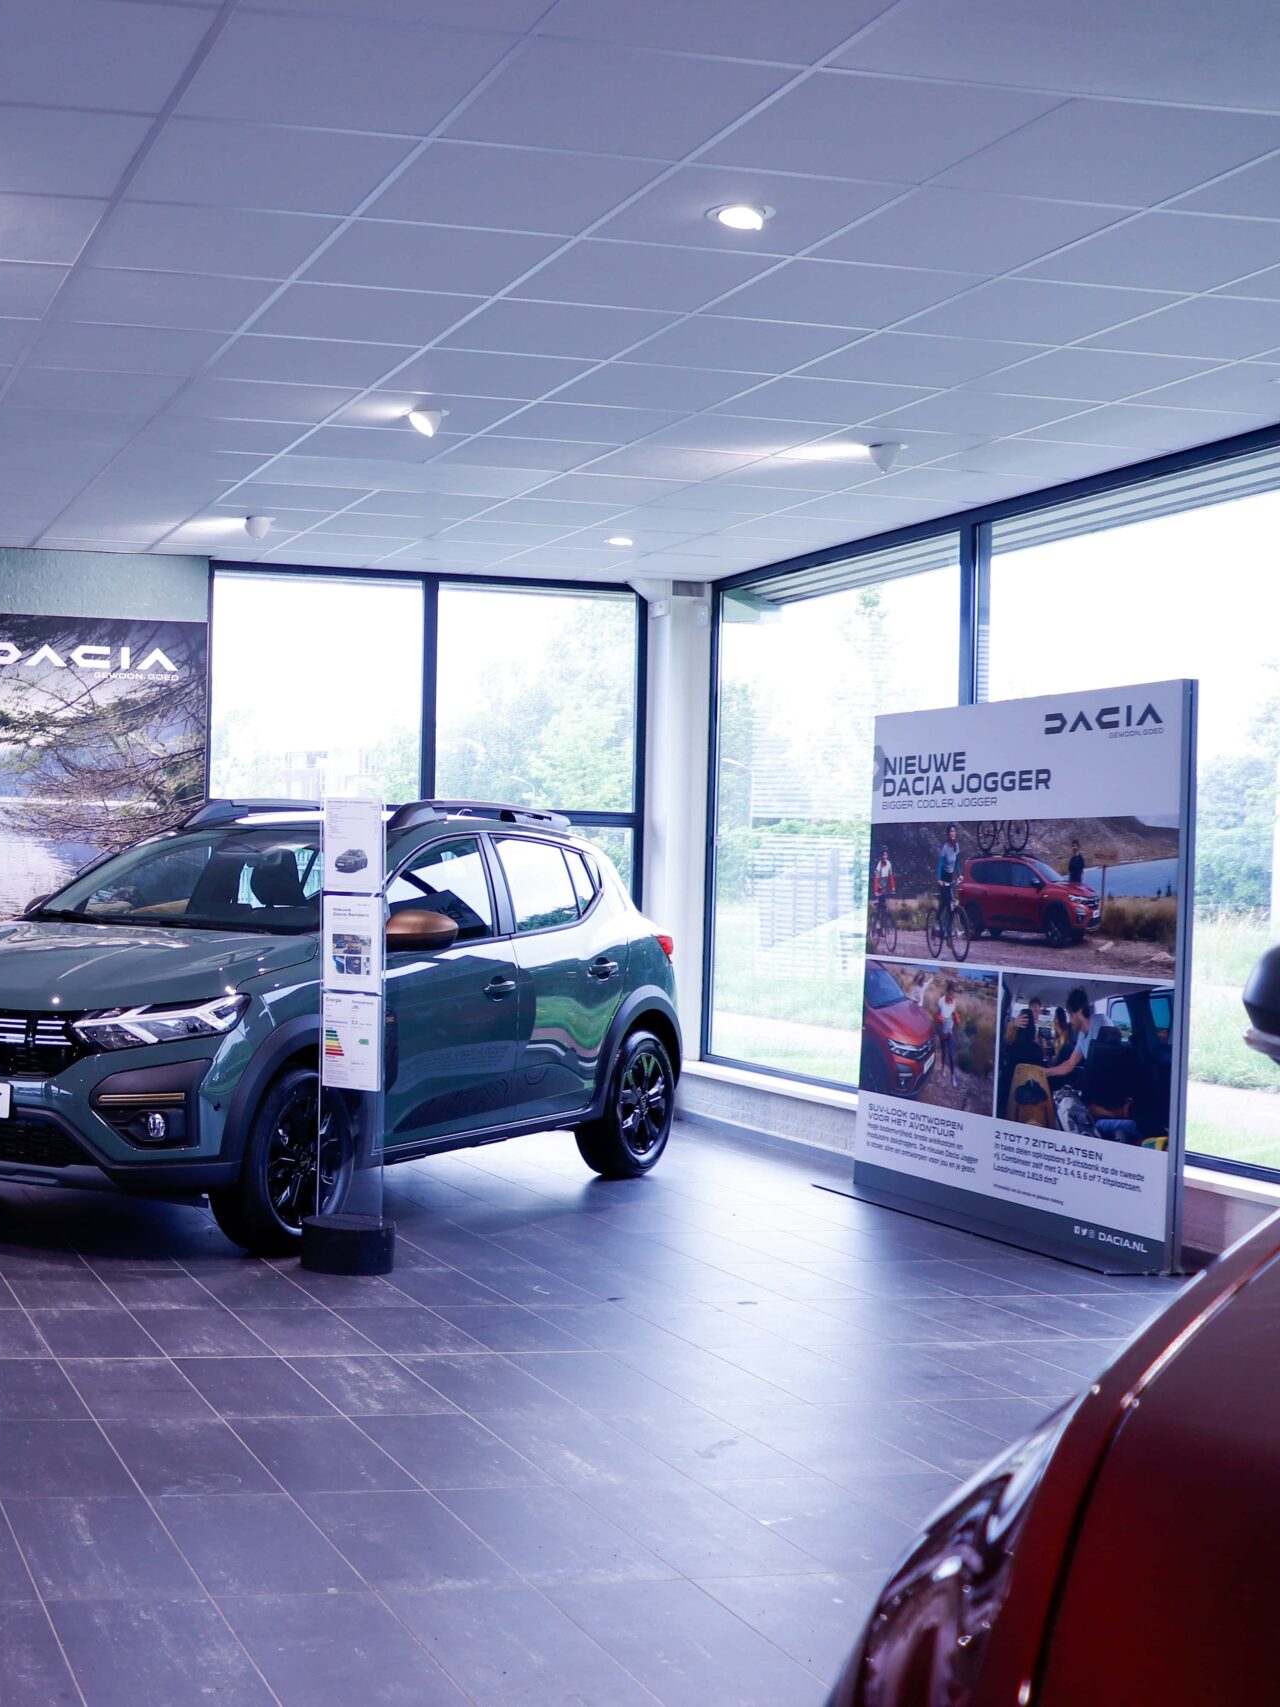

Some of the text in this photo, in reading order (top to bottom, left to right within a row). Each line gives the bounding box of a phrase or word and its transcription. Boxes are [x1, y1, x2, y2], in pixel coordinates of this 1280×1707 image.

[148, 673, 179, 681] GOED
[1044, 703, 1163, 735] DACIA
[883, 751, 966, 776] NIEUWE
[882, 768, 1052, 797] DACIA JOGGER
[957, 796, 998, 807] JOGGER
[868, 1103, 964, 1131] SUV-LOOK ONTWORPEN
[868, 1112, 956, 1138] VOOR HET AVONTUUR
[995, 1130, 1103, 1161] 2 TOT 7 ZITPLAATSEN
[993, 1163, 1026, 1178] Laadruimte
[994, 1141, 1145, 1182] In twee delen opklapbare 3-zitsbank op de tweede
[1001, 1153, 1031, 1167] Combineer
[1032, 1159, 1043, 1170] zelf
[1043, 1163, 1056, 1173] met
[1083, 1171, 1088, 1180] 6
[1088, 1172, 1096, 1182] of
[1096, 1175, 1102, 1183] 7
[1098, 1231, 1148, 1253] DACIA.NL
